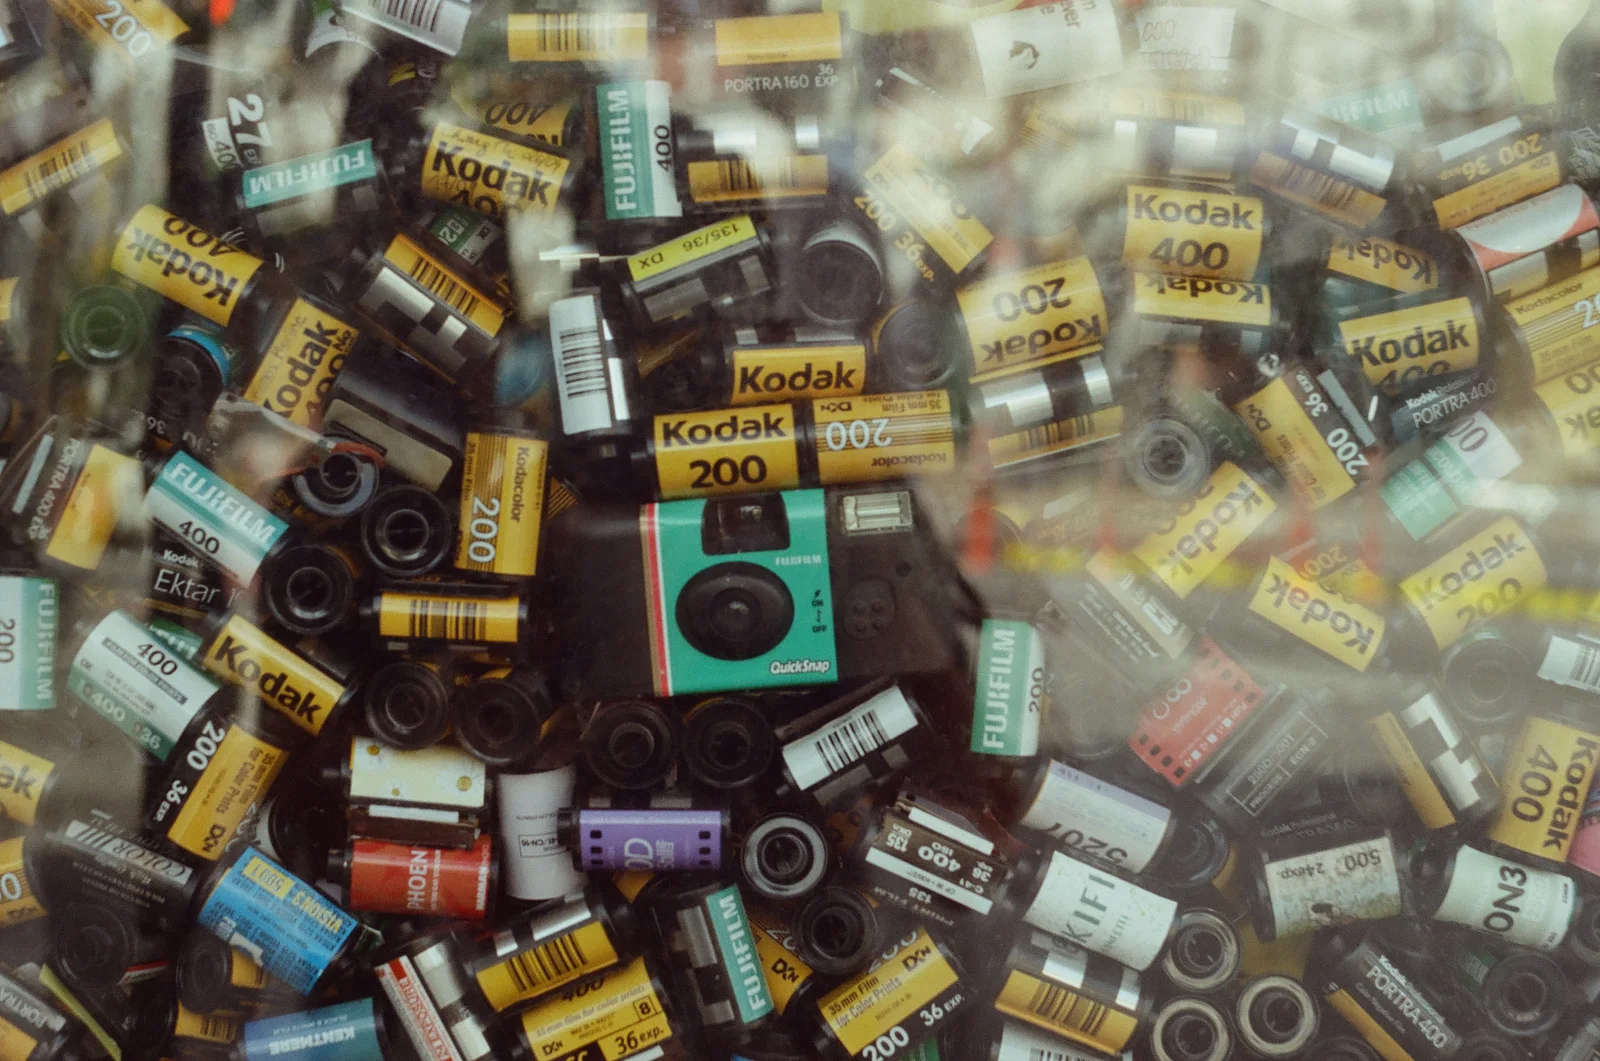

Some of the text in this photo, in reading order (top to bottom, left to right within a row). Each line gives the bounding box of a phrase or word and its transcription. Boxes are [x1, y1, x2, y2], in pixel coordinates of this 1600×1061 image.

[95, 0, 153, 57] 200
[724, 77, 781, 93] PORTRA
[785, 77, 809, 89] 160
[227, 94, 274, 148] 27
[607, 89, 636, 211] FUJIFILM
[654, 125, 672, 172] 400
[1462, 158, 1490, 182] 36
[1498, 133, 1543, 166] 200
[248, 148, 367, 195] FUJIFILM
[432, 141, 553, 205] Kodak
[854, 195, 896, 231] 200
[894, 231, 925, 262] 36
[1133, 194, 1255, 230] Kodak
[163, 216, 241, 257] 400
[638, 223, 740, 269] 135/36 DX
[1148, 237, 1229, 270] 400
[127, 226, 240, 308] Kodak
[1338, 238, 1432, 284] Kodak
[992, 276, 1071, 322] 200
[1147, 274, 1264, 305] Kodak
[1515, 281, 1584, 315] Kodacolor
[982, 314, 1101, 364] Kodak
[1350, 320, 1470, 367] Kodak
[738, 361, 857, 395] Kodak
[1406, 384, 1439, 408] Kodak
[881, 403, 905, 414] Film
[1412, 378, 1496, 428] PORTRA 400
[662, 412, 786, 448] Kodak
[824, 418, 947, 469] Kodacolor 200
[1305, 393, 1328, 418] 36
[1326, 428, 1369, 476] 200
[36, 437, 80, 517] PORTRA 400
[689, 455, 767, 489] 200
[169, 461, 277, 545] FUJIFILM
[467, 446, 530, 564] Kodacolor 200
[179, 520, 220, 555] 400
[1167, 481, 1264, 582] Kodak
[162, 549, 200, 568] Kodak
[1414, 532, 1526, 610] Kodak
[154, 568, 221, 604] Ektar
[812, 625, 827, 633] OFF
[1266, 572, 1376, 656] Kodak
[37, 584, 56, 701] FUJIFILM
[137, 643, 178, 676] 400
[214, 635, 323, 725] Kodak
[769, 660, 831, 675] QuickSnap
[982, 629, 1016, 749] FUJIFILM
[1028, 667, 1044, 714] 200
[185, 721, 226, 771] 200
[166, 779, 190, 806] 36
[232, 761, 255, 788] Color
[1510, 744, 1559, 822] 400
[1544, 735, 1598, 852] Kodak
[214, 786, 240, 817] Prints
[112, 838, 186, 881] COLOR
[885, 833, 910, 853] 135
[917, 845, 962, 873] 400
[931, 841, 954, 856] ISO
[1344, 849, 1382, 871] 500
[250, 862, 286, 892] 500T
[407, 850, 429, 911] PHOEN
[907, 886, 933, 904] 135
[958, 877, 986, 894] C-41
[971, 867, 992, 883] 36
[291, 890, 345, 933] VISION3
[1060, 873, 1116, 944] KIFI
[1483, 866, 1527, 932] ON3
[719, 894, 765, 1011] FUJIFILM
[1378, 955, 1409, 986] Kodak
[836, 976, 904, 1029] for Color Prints
[858, 977, 880, 994] Film
[1, 987, 48, 1029] PORTRA
[638, 1001, 651, 1015] 8
[862, 994, 966, 1061] 200 36 EXP.
[1366, 966, 1449, 1049] PORTRA 400
[267, 1023, 356, 1056] KENTMERE
[613, 1031, 640, 1055] 36
[638, 1024, 665, 1042] exp.
